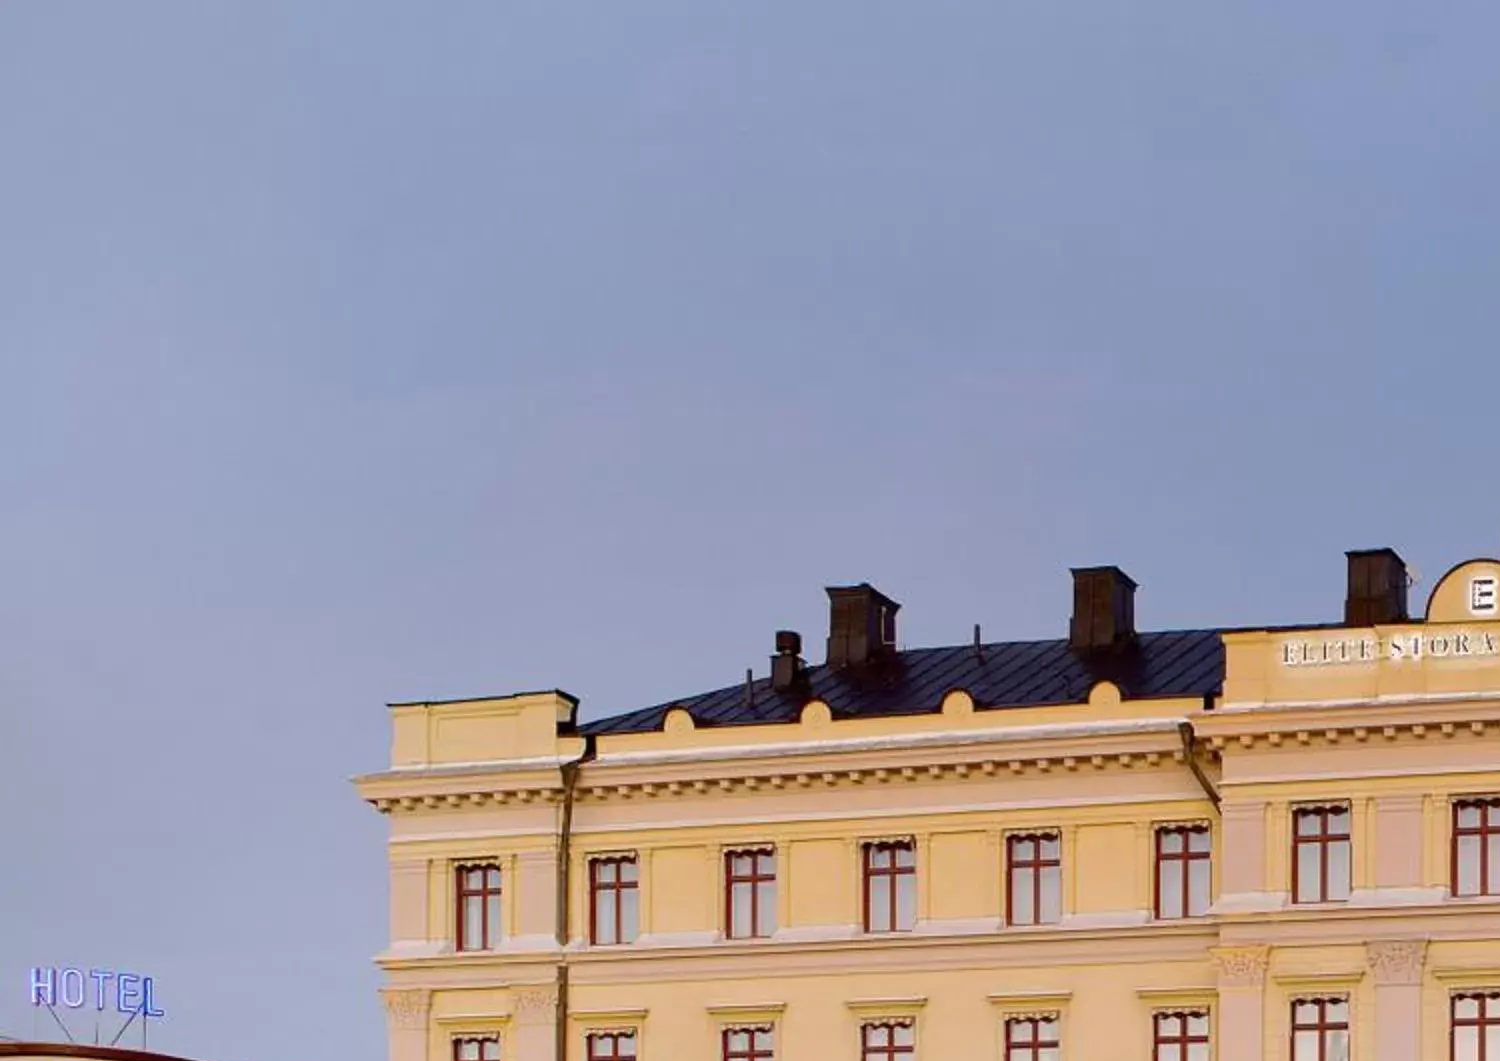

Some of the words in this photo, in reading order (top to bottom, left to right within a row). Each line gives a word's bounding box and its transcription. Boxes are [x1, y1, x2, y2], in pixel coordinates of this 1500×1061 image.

[1471, 577, 1495, 612] E
[1281, 636, 1377, 668] ELITE
[1389, 627, 1497, 660] STORA
[31, 967, 165, 1017] HOTEL
